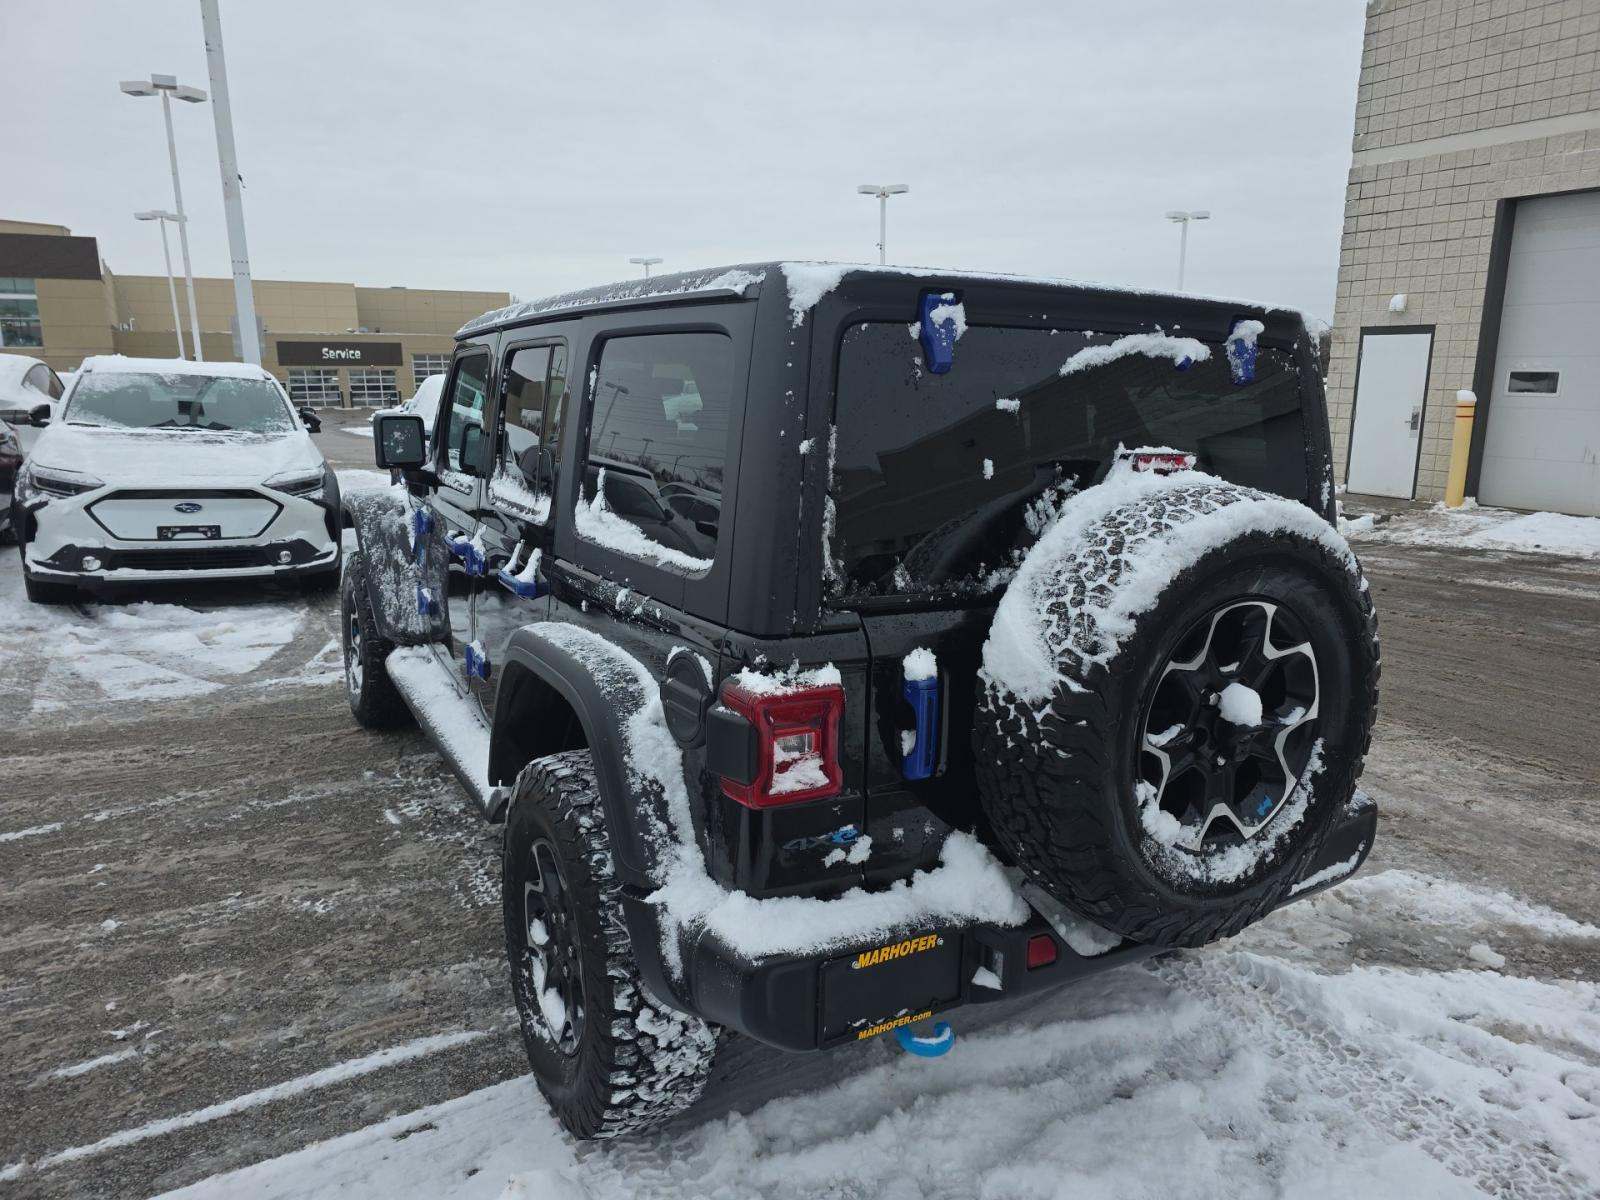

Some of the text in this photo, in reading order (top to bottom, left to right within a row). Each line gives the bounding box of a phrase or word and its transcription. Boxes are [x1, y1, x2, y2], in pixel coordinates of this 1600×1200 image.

[321, 347, 361, 359] Service
[857, 934, 938, 969] MARHOFER
[857, 1010, 932, 1040] MARHOFER.com
